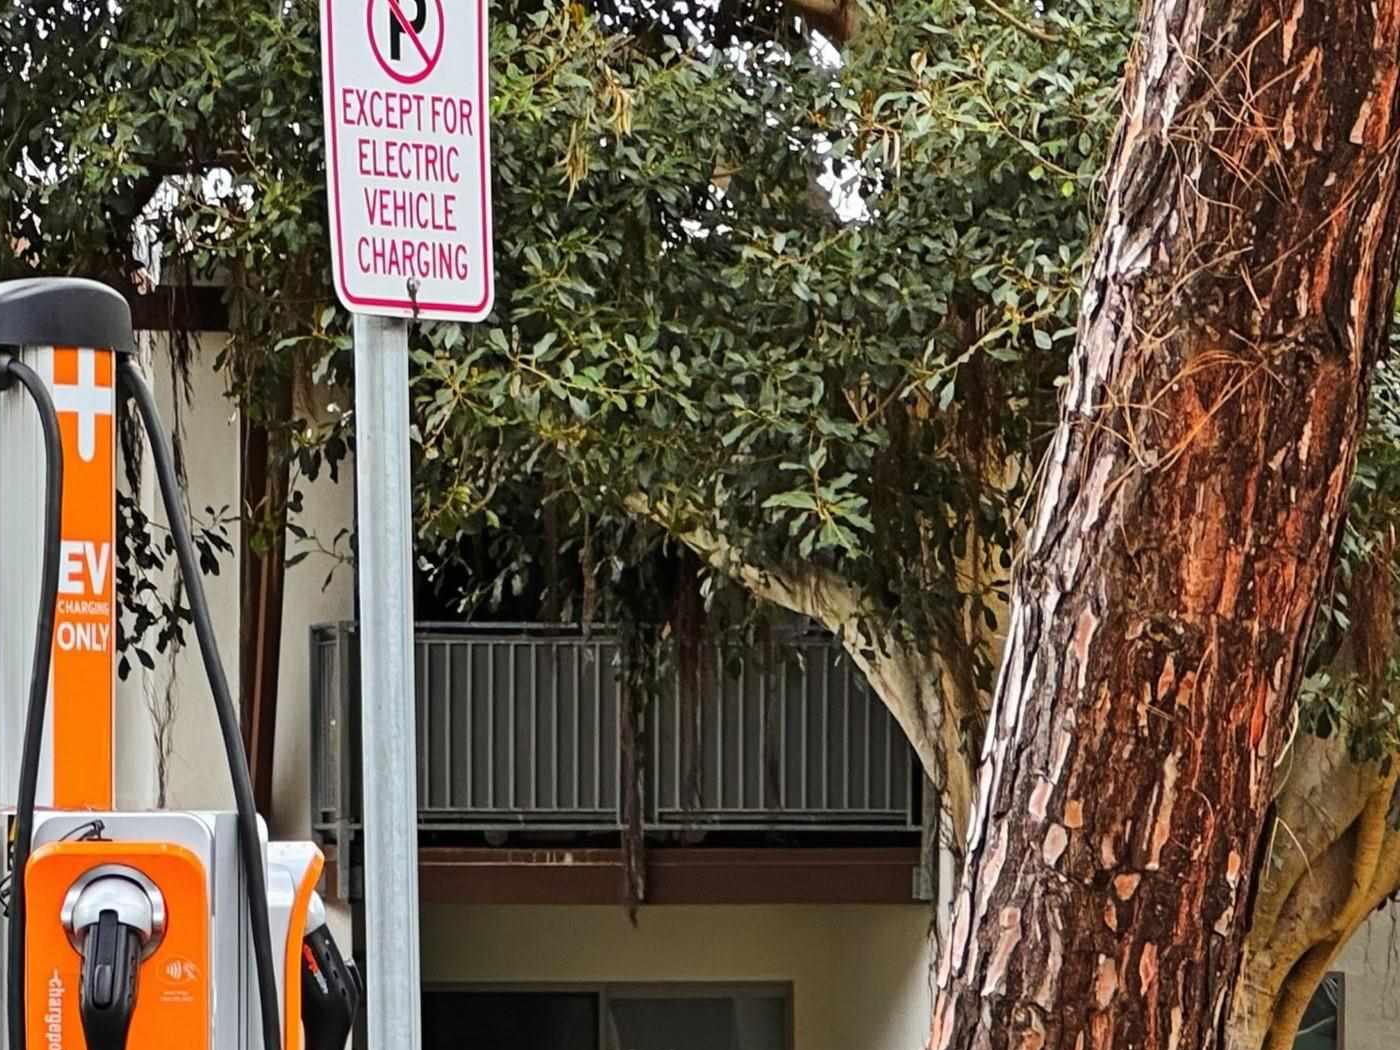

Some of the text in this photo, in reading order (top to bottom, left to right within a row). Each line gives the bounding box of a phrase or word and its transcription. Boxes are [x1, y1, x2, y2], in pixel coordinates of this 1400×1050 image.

[342, 87, 473, 137] EXCEPT FOR
[358, 138, 460, 184] ELECTRIC
[364, 187, 457, 231] VEHICLE
[357, 236, 468, 281] CHARGING
[58, 540, 111, 595] EV
[57, 599, 110, 616] CHARGING
[57, 621, 110, 652] ONLY
